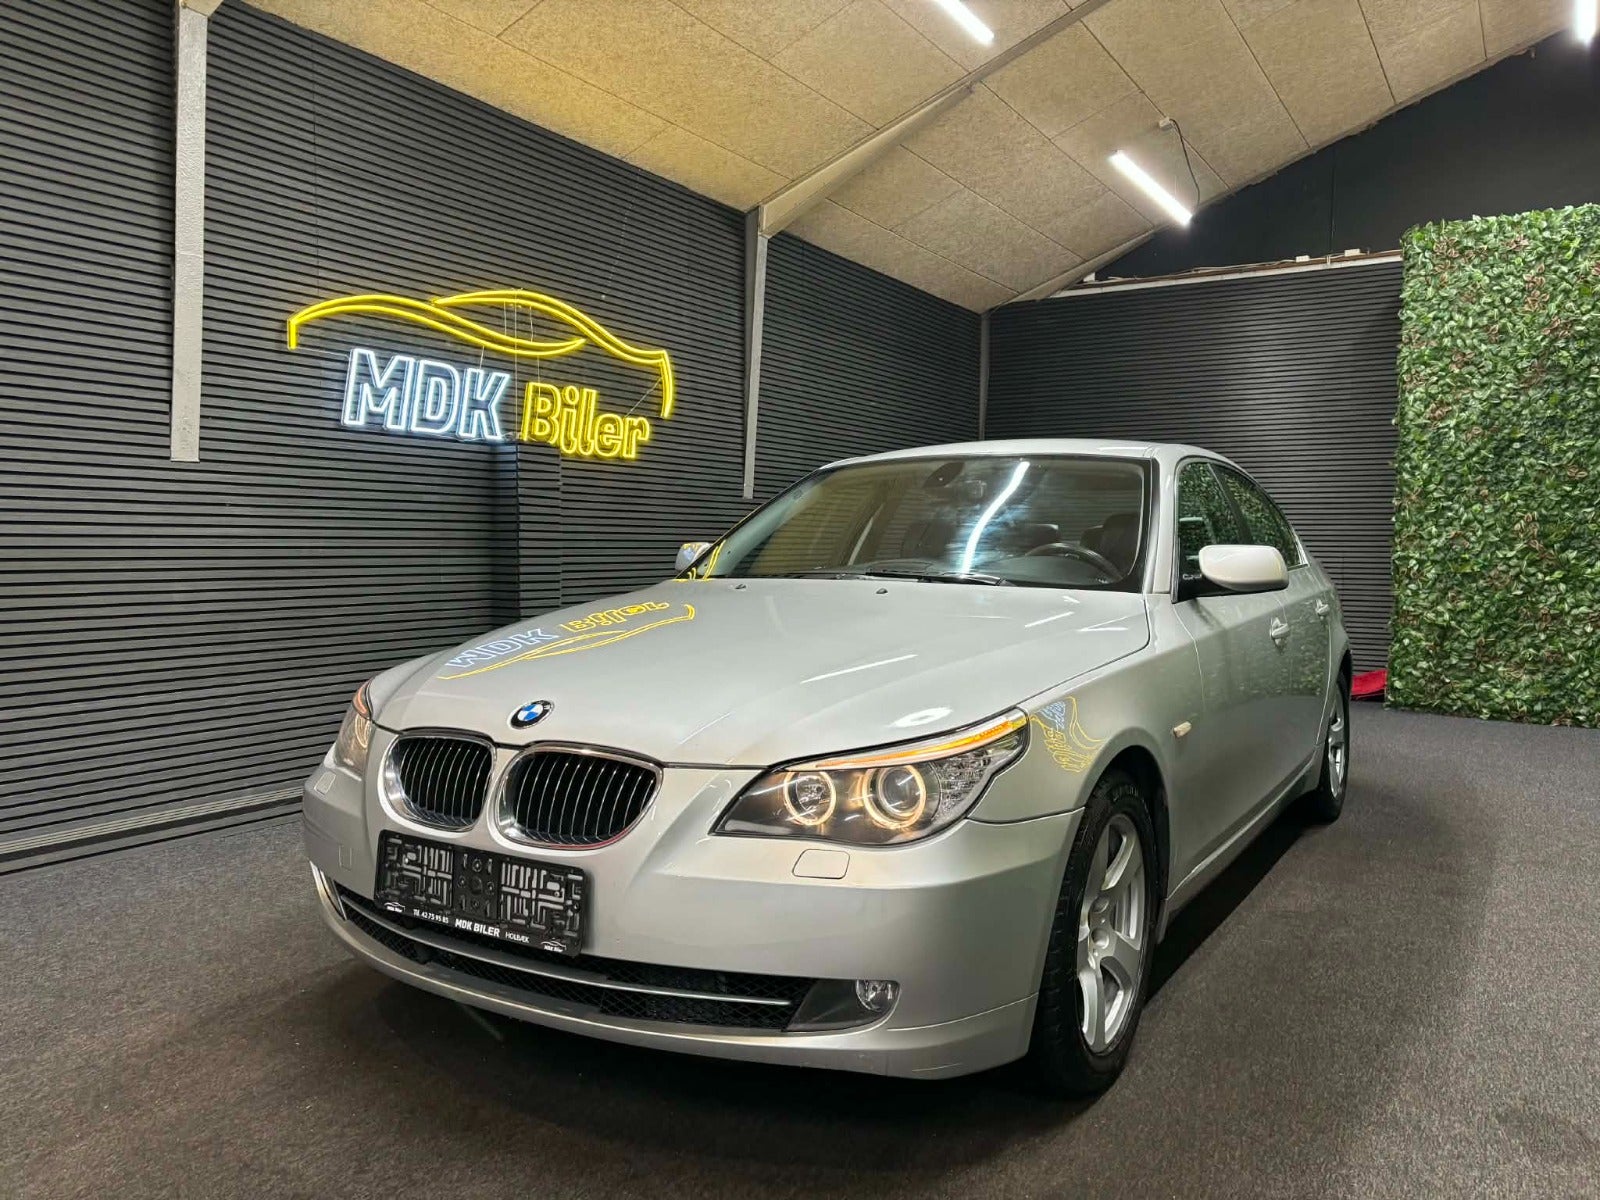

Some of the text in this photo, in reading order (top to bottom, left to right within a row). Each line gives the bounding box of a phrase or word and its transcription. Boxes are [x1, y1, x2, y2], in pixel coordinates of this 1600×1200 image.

[341, 347, 651, 460] MDK Biler
[455, 918, 500, 937] MDK BILER
